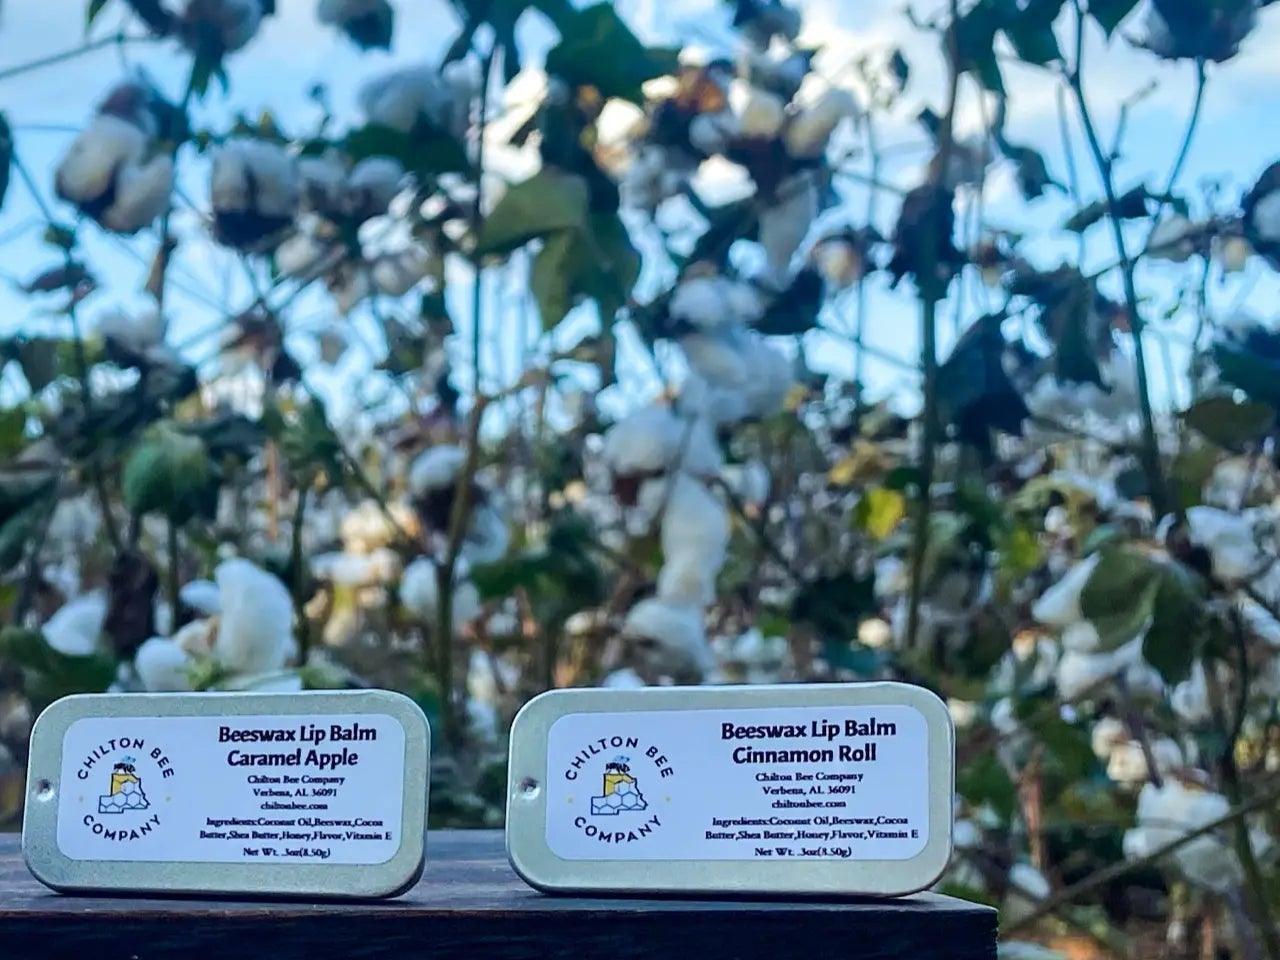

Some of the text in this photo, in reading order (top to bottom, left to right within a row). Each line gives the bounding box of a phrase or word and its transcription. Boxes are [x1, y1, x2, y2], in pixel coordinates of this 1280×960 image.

[219, 724, 376, 743] Beeswax Lip Balm
[722, 719, 896, 741] Beeswax Lip Balm
[78, 738, 174, 780] CHILTON BEE
[228, 749, 358, 769] Caramel Apple
[566, 736, 673, 781] CHILTON BEE
[733, 744, 876, 763] Cinnamon Roll
[248, 775, 345, 786] Chilton Bee Company
[755, 772, 863, 784] Chilton Bee Company
[84, 814, 160, 841] COMPANY
[575, 815, 661, 843] COMPANY
[911, 830, 918, 839] E
[243, 848, 259, 856] Net
[755, 847, 772, 856] Net
